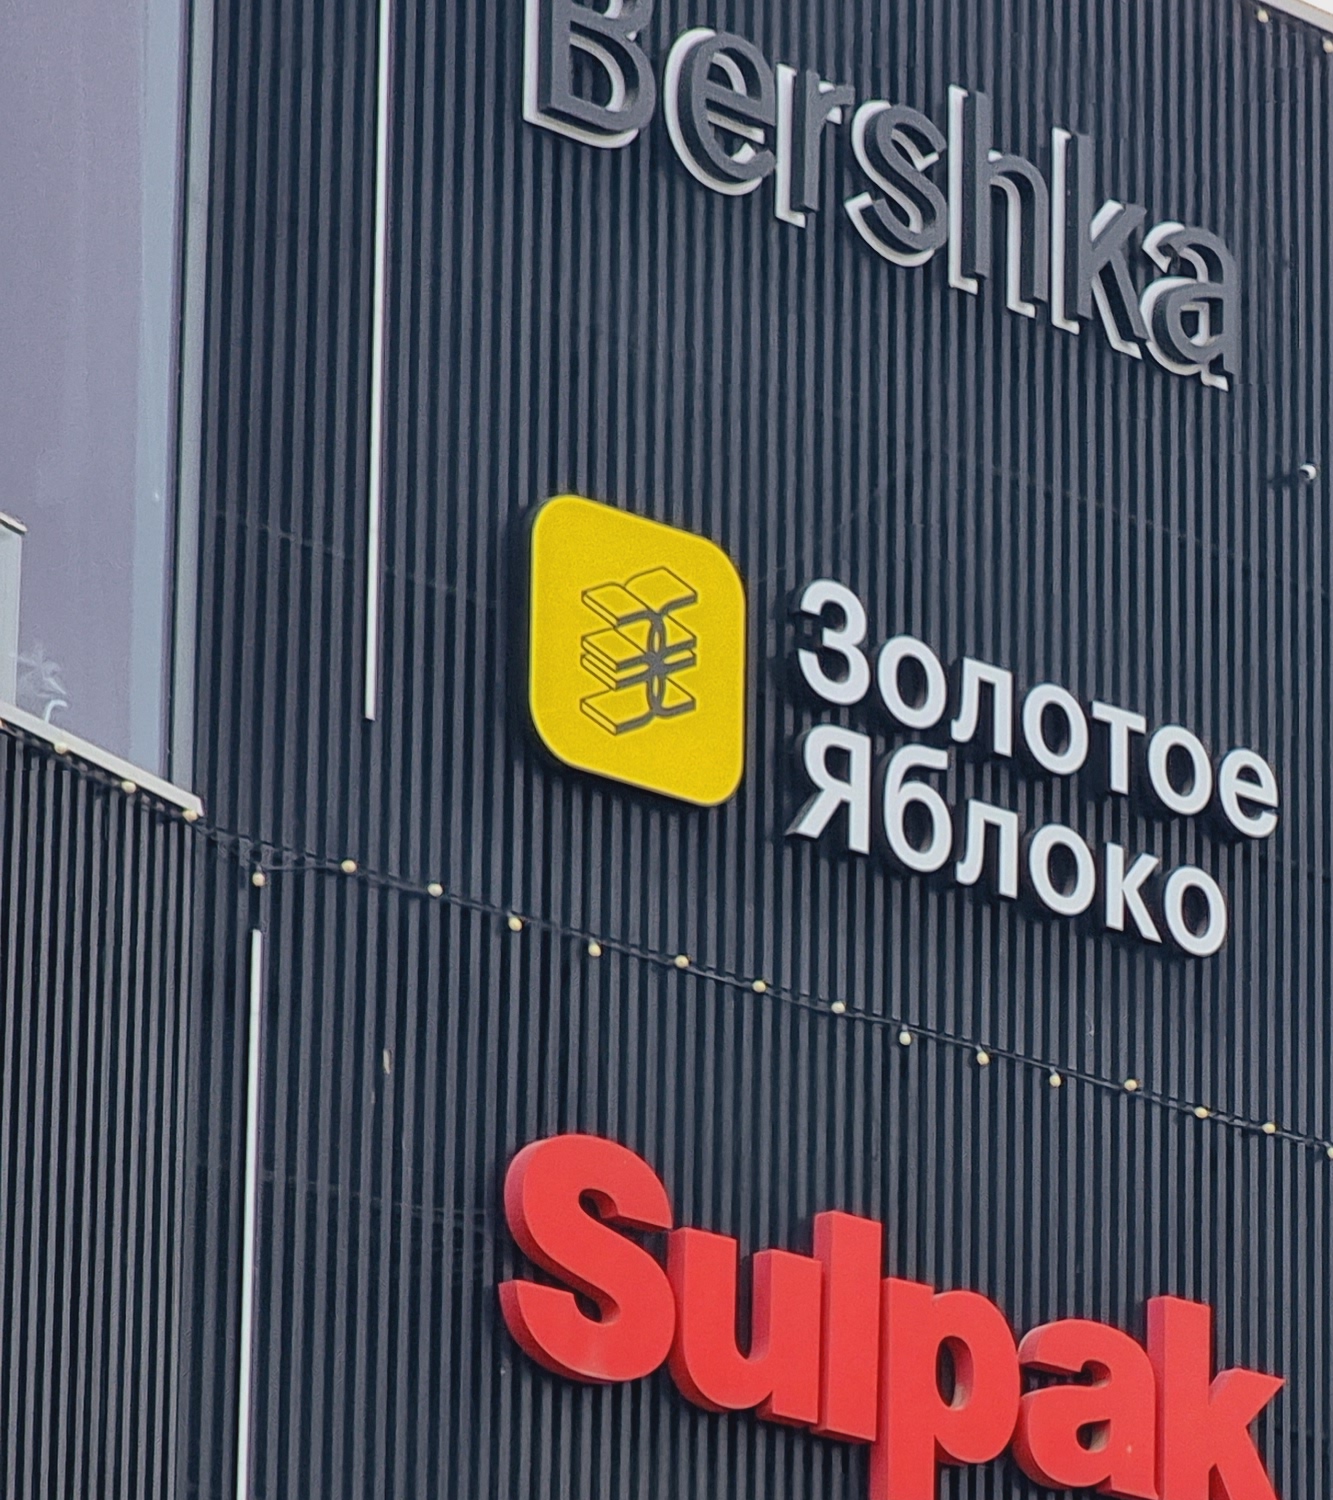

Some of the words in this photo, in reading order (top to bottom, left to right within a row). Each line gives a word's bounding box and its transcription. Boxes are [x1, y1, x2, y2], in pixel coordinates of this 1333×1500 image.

[523, 0, 1236, 391] Bershka
[797, 579, 1279, 839] Золотое
[790, 724, 1228, 957] Яблоко
